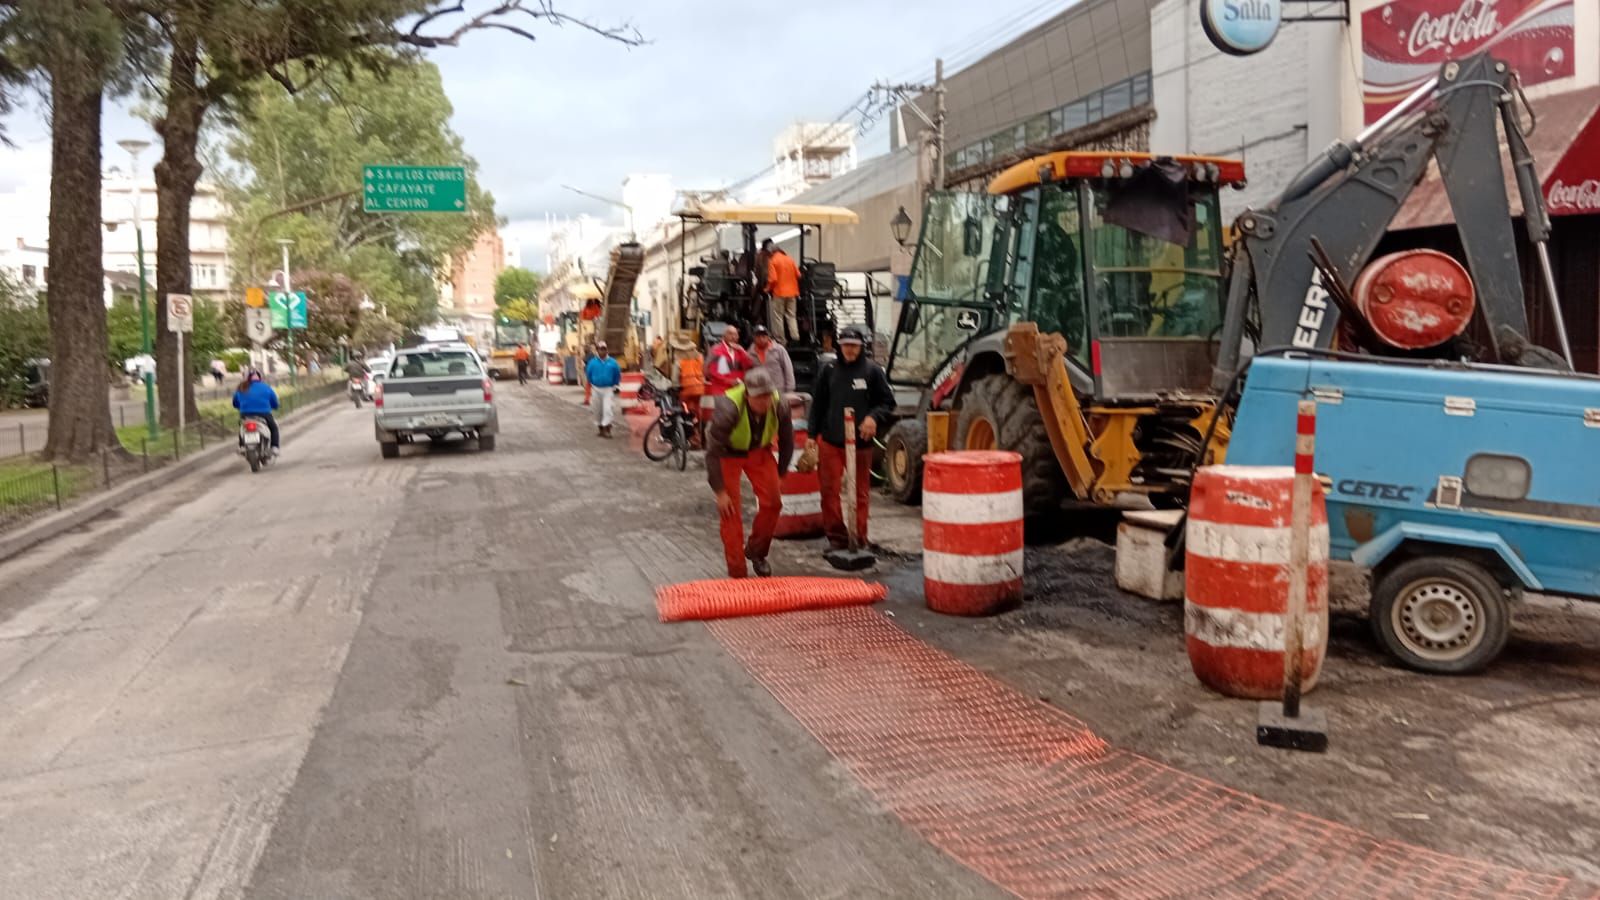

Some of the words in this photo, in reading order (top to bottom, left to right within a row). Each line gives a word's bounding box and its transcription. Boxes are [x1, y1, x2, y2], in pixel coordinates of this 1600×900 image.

[405, 169, 425, 180] LOS
[377, 183, 436, 194] CAFAYATE
[366, 197, 380, 208] AL
[385, 198, 429, 209] CENTRO
[1337, 479, 1415, 503] CETEC
